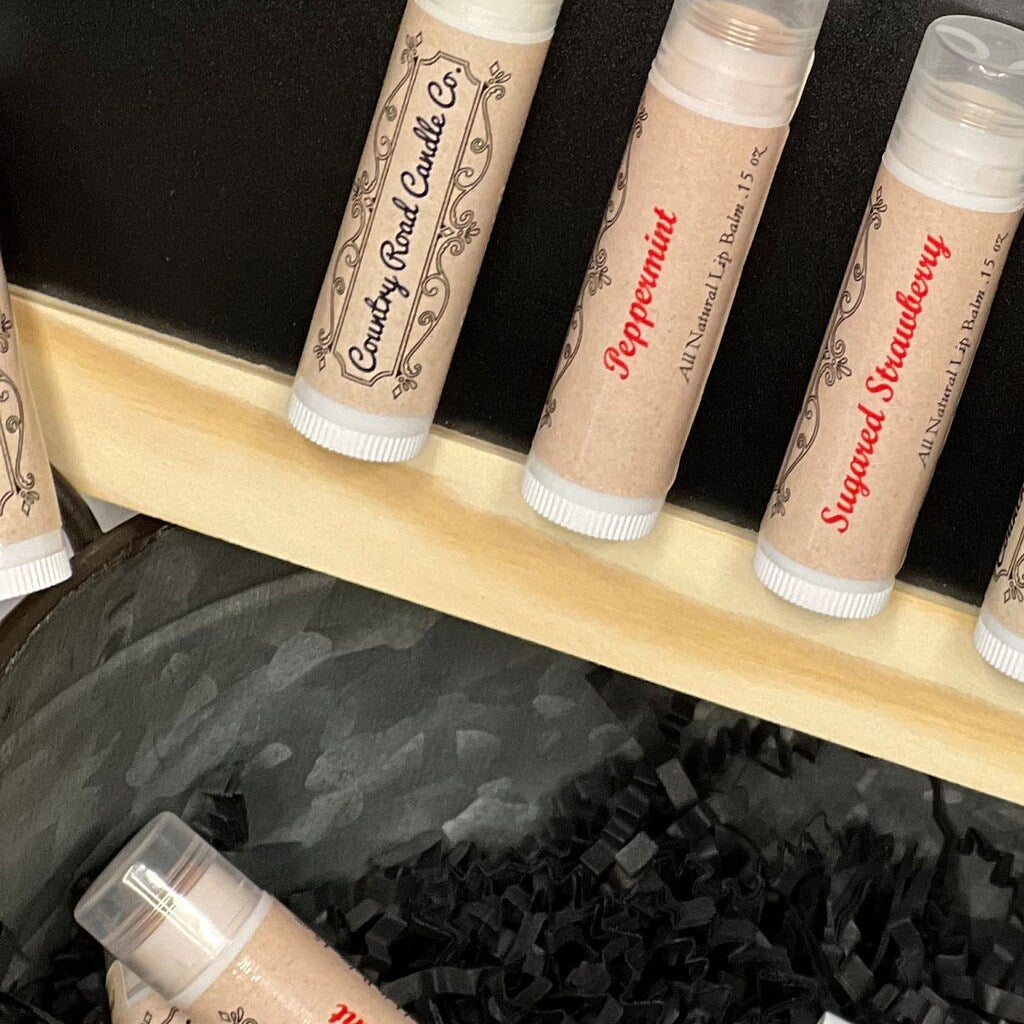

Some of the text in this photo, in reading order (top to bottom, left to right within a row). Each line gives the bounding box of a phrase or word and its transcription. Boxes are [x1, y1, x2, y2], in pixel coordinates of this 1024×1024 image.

[750, 146, 768, 166] oz
[349, 67, 462, 373] Country Road Candle Co.
[719, 204, 745, 245] Balm
[993, 232, 1009, 252] oz
[709, 251, 732, 281] Lip
[604, 207, 678, 380] Peppermint
[961, 289, 985, 330] Balm
[685, 283, 718, 349] Natural
[679, 352, 697, 383] All
[950, 337, 970, 365] Lip
[820, 234, 951, 533] Sugared Strawberry
[926, 370, 957, 434] Natural
[919, 439, 934, 467] All
